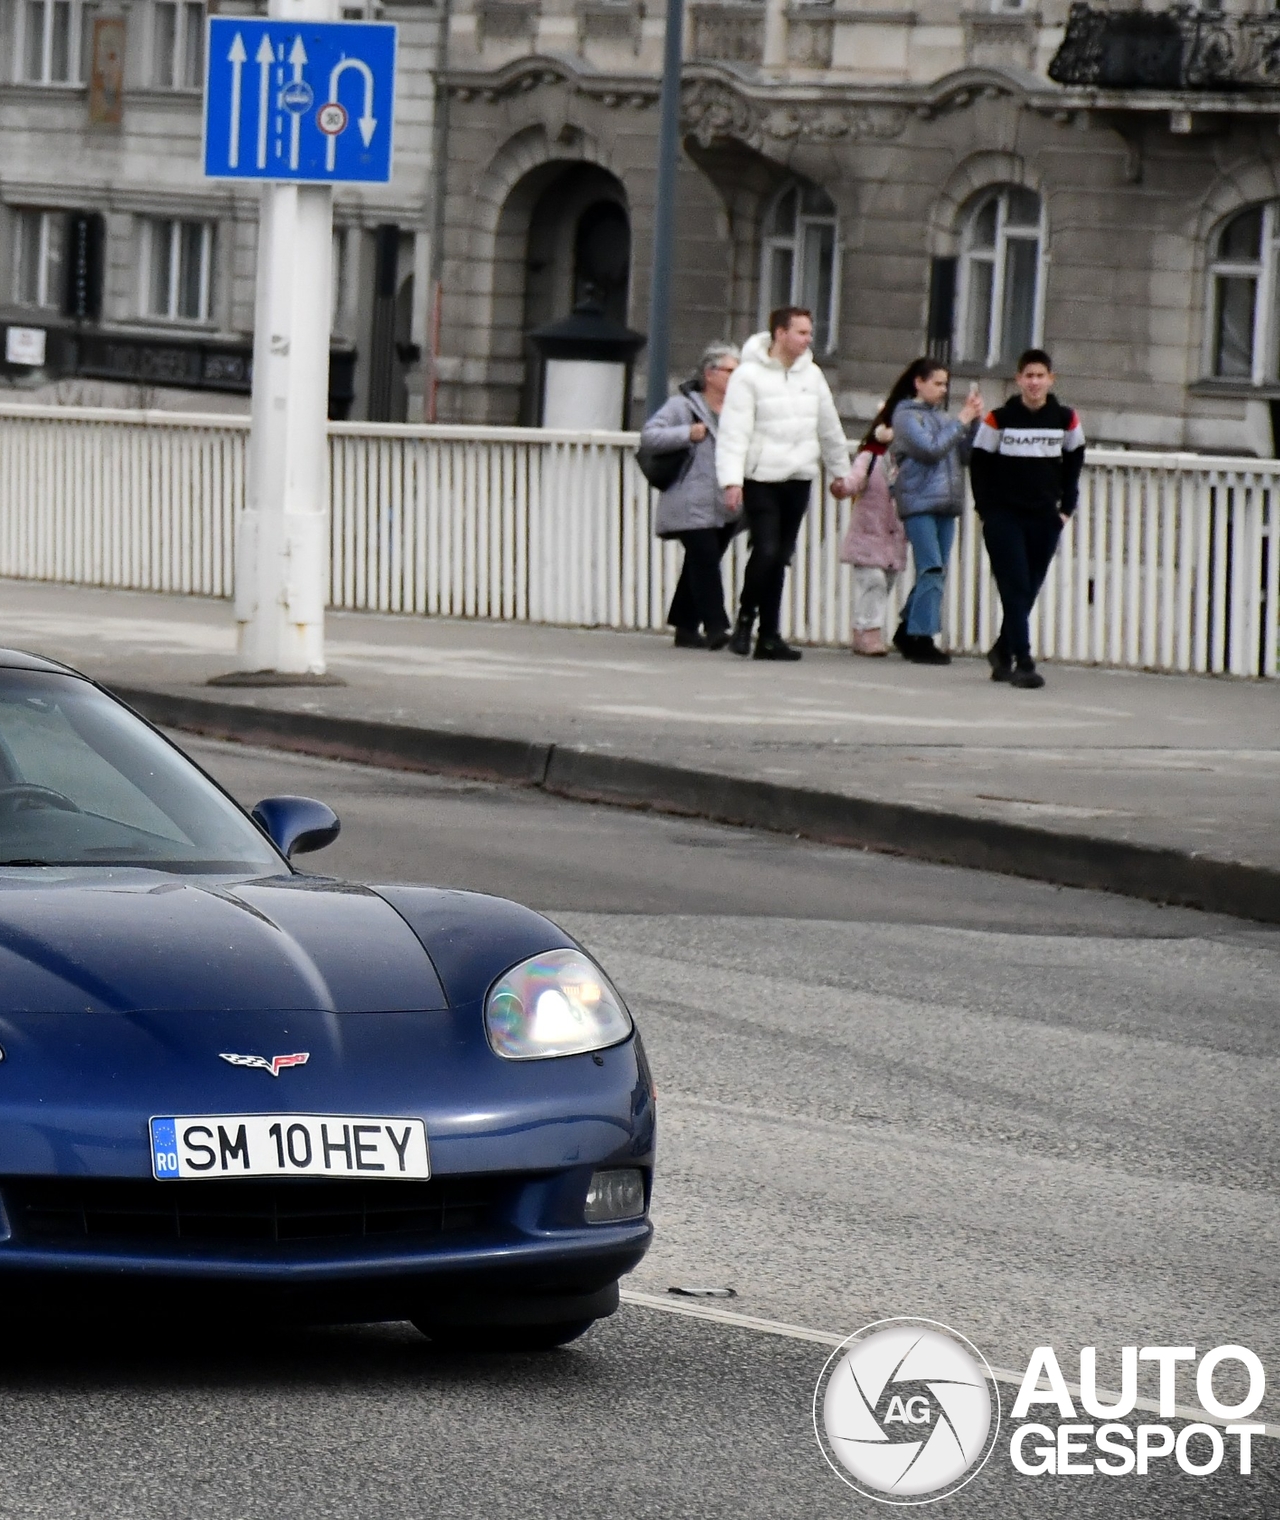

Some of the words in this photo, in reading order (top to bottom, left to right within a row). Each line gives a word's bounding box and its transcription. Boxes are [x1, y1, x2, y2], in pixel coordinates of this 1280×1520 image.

[326, 113, 341, 125] 30
[183, 1124, 251, 1171] SM
[269, 1122, 313, 1168] 10
[321, 1123, 412, 1172] HEY
[157, 1152, 178, 1171] RO
